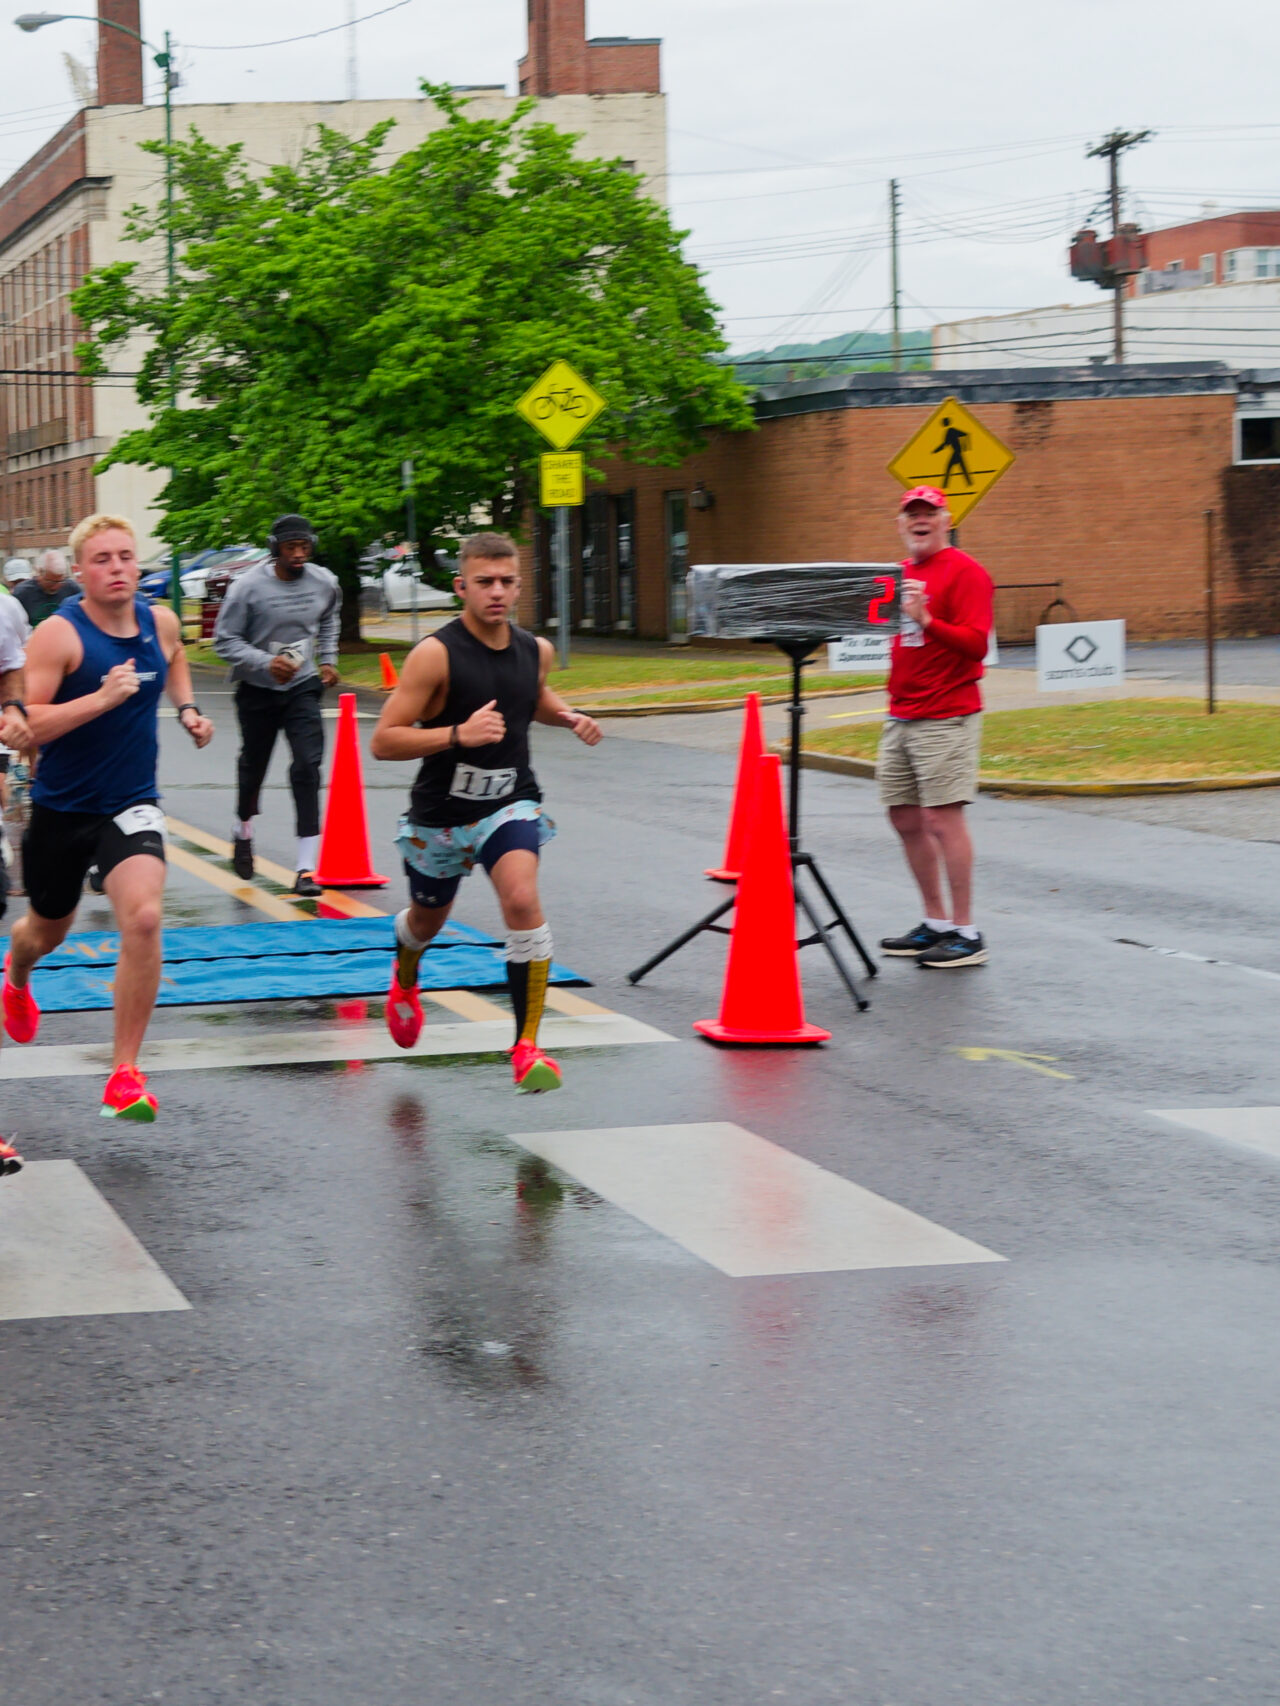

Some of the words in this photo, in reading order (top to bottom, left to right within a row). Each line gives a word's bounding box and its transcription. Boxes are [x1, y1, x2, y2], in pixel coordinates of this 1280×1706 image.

[551, 474, 574, 483] THE
[867, 576, 896, 624] 2
[456, 771, 516, 796] 117
